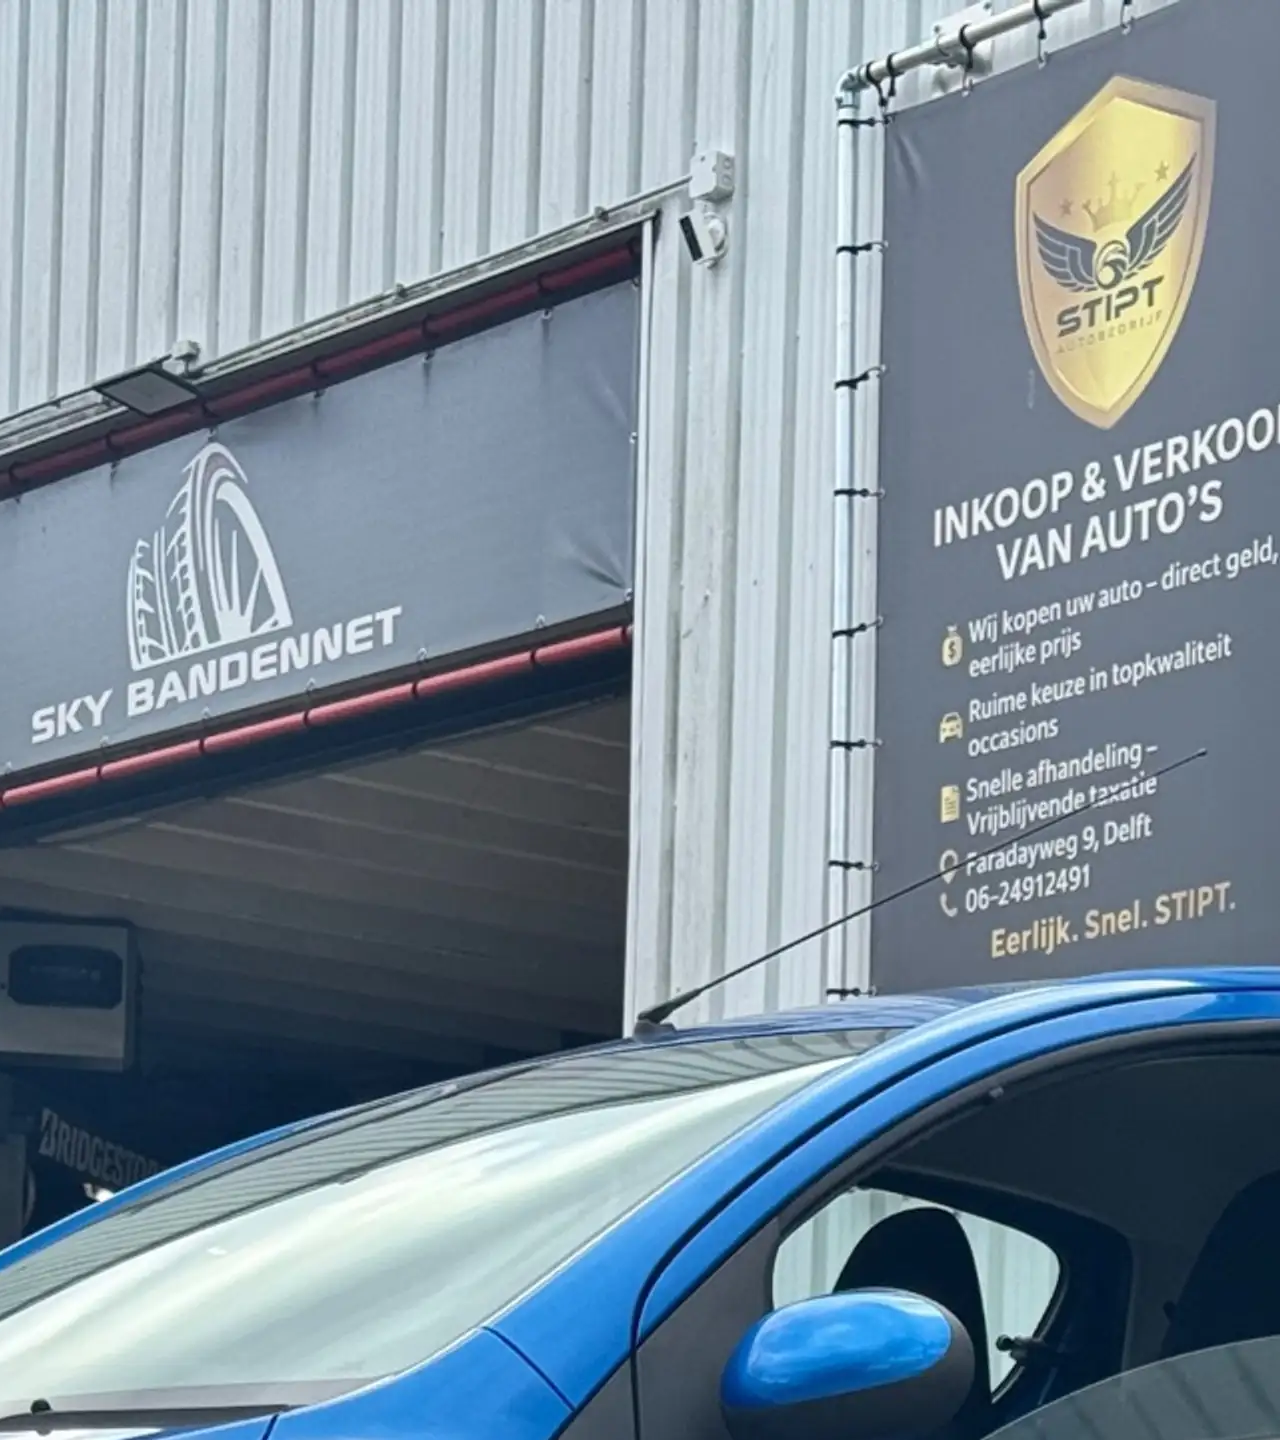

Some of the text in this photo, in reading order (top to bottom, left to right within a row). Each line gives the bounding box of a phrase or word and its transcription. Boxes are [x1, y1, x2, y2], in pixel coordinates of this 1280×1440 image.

[1057, 274, 1165, 338] STIPT
[933, 471, 1073, 547] INKOOP
[1082, 461, 1107, 502] &
[996, 481, 1223, 581] VAN AUTO'S
[969, 613, 998, 644] Wij
[1002, 601, 1061, 635] kopen
[1066, 591, 1095, 617] uw
[1098, 578, 1143, 609] auto
[1161, 553, 1220, 591] direct
[1226, 535, 1279, 578] geld,
[31, 605, 403, 745] SKY BANDENNET
[969, 627, 1082, 679] eerlijke prijs
[969, 633, 1233, 723] Ruime keuze in topkwaliteit
[968, 717, 1059, 757] occasions
[966, 768, 1022, 801] Snelle
[1026, 742, 1142, 789] afhandeling
[966, 771, 1158, 836] Vrijblijvende taxatie
[966, 812, 1153, 877] Faradayweg 9, Delft
[966, 863, 1091, 914] 06-24912491
[991, 881, 1236, 959] Eerlijk. Snel. STIPT.
